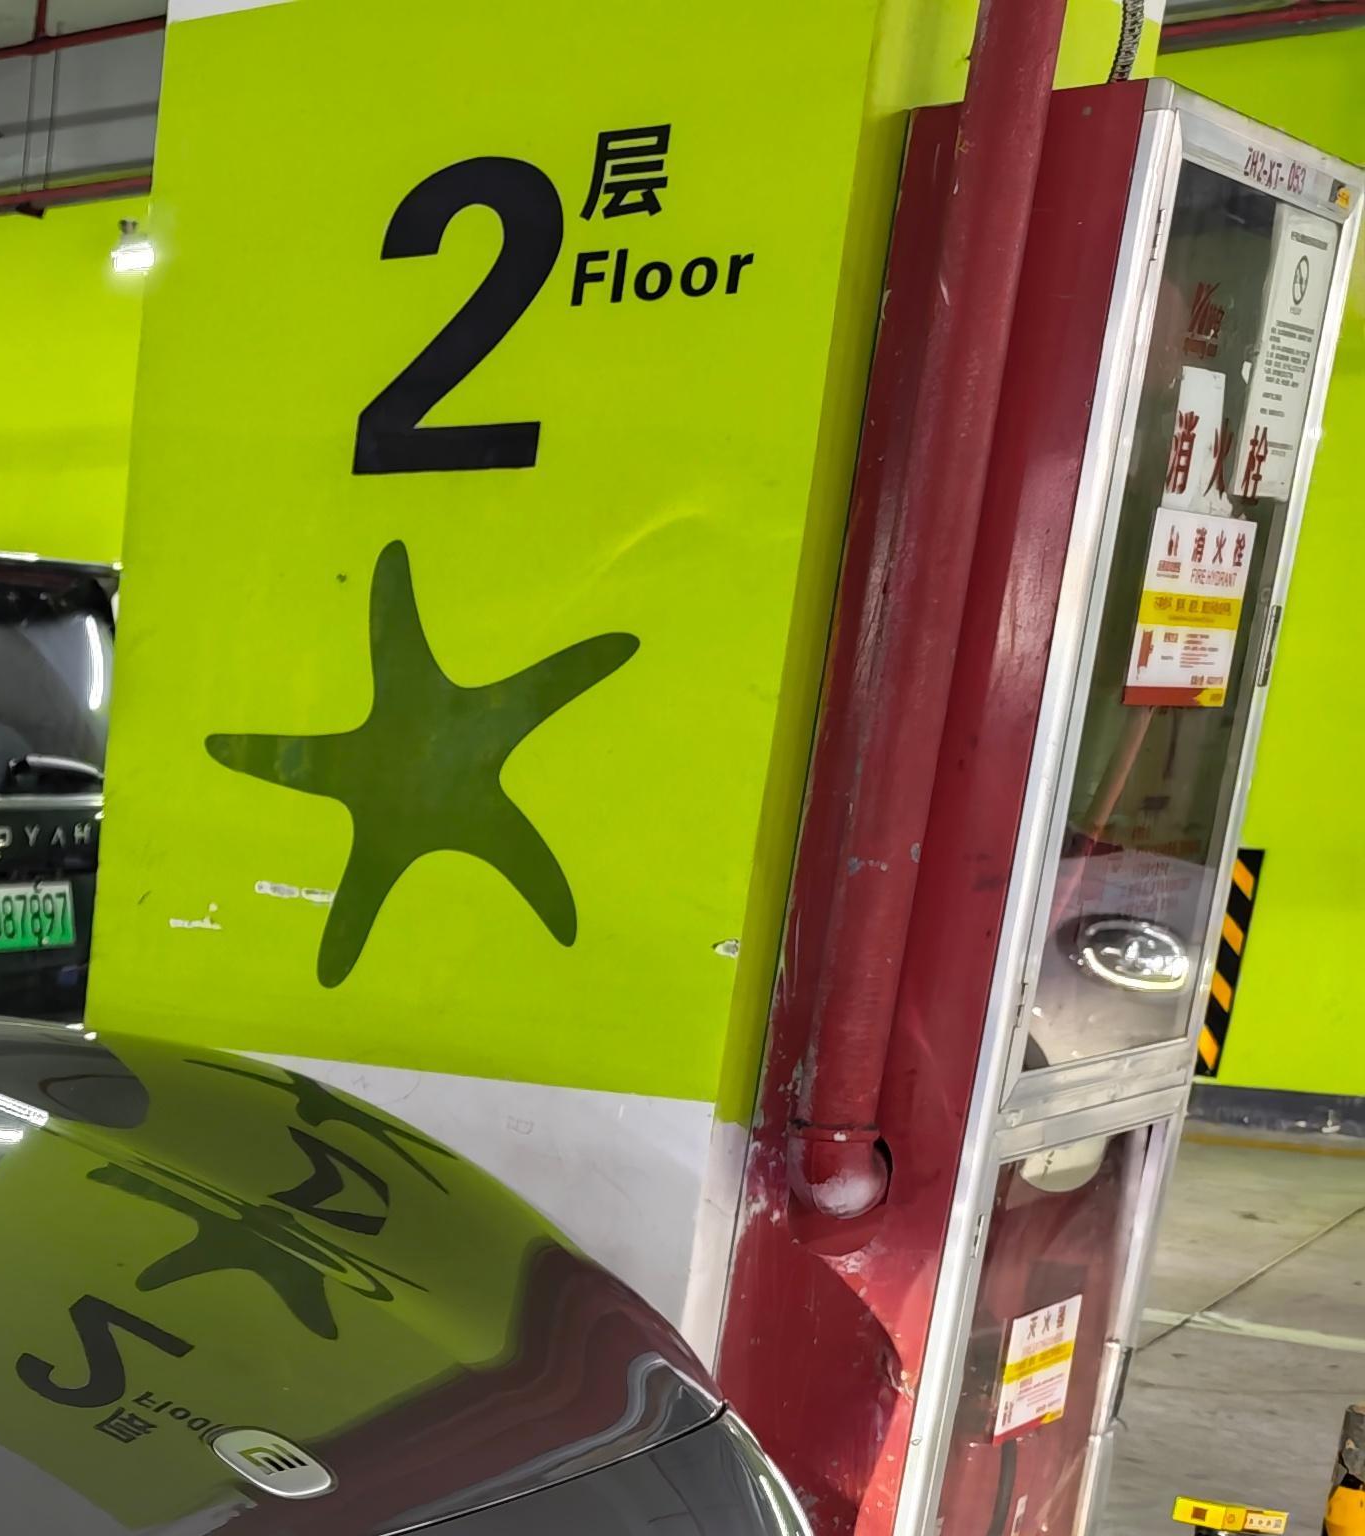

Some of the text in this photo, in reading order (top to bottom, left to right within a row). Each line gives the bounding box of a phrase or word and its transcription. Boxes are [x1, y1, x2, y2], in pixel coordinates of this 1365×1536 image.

[352, 123, 672, 475] 2 层
[570, 247, 755, 307] Floor
[1165, 410, 1269, 505] 消火栓
[1190, 527, 1246, 567] 消火栓
